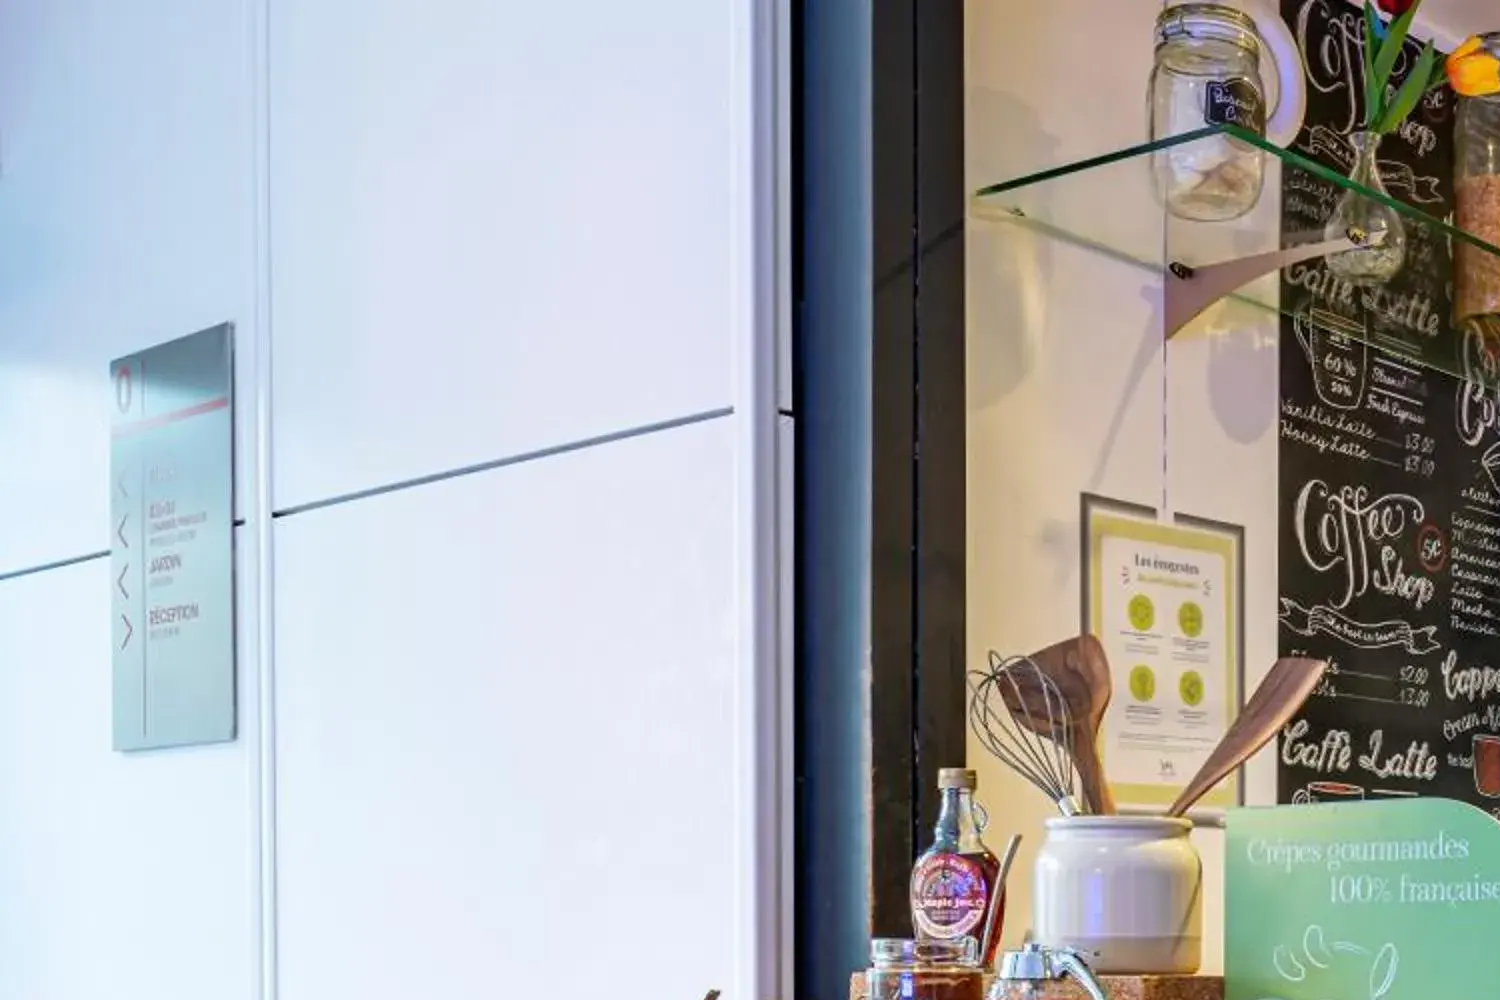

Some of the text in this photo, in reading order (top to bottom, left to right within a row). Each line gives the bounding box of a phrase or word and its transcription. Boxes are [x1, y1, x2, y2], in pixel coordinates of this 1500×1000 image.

[1295, 479, 1425, 610] Coffee
[1373, 545, 1435, 610] Shop
[1358, 729, 1438, 781] Latte
[1246, 830, 1471, 873] Crêpes gourmandes
[1329, 873, 1392, 904] 100%
